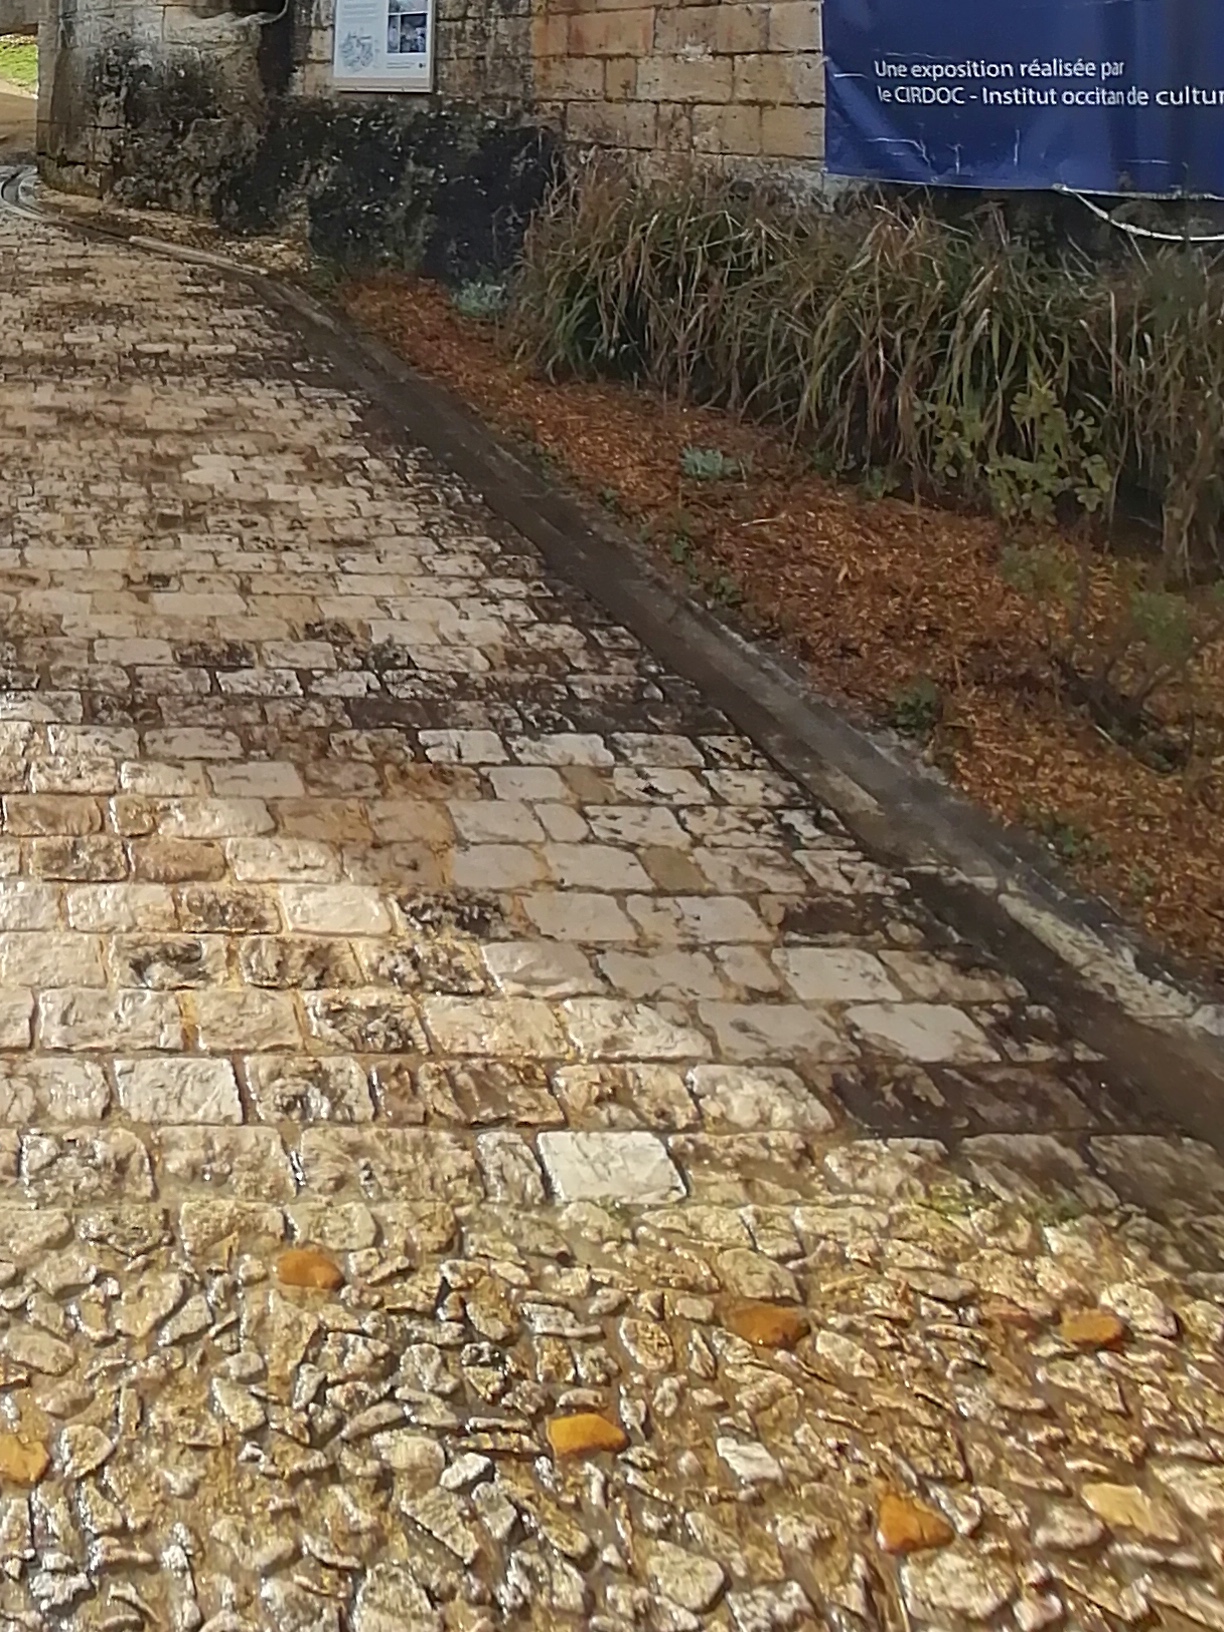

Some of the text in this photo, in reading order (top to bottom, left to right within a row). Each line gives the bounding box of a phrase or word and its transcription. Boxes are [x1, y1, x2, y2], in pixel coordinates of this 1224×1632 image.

[874, 58, 1125, 82] Une exposition réalisée par
[877, 85, 893, 103] le
[894, 86, 966, 105] CIRDOC
[982, 87, 1058, 106] Institut
[1061, 86, 1125, 106] occitan
[1126, 85, 1150, 106] de
